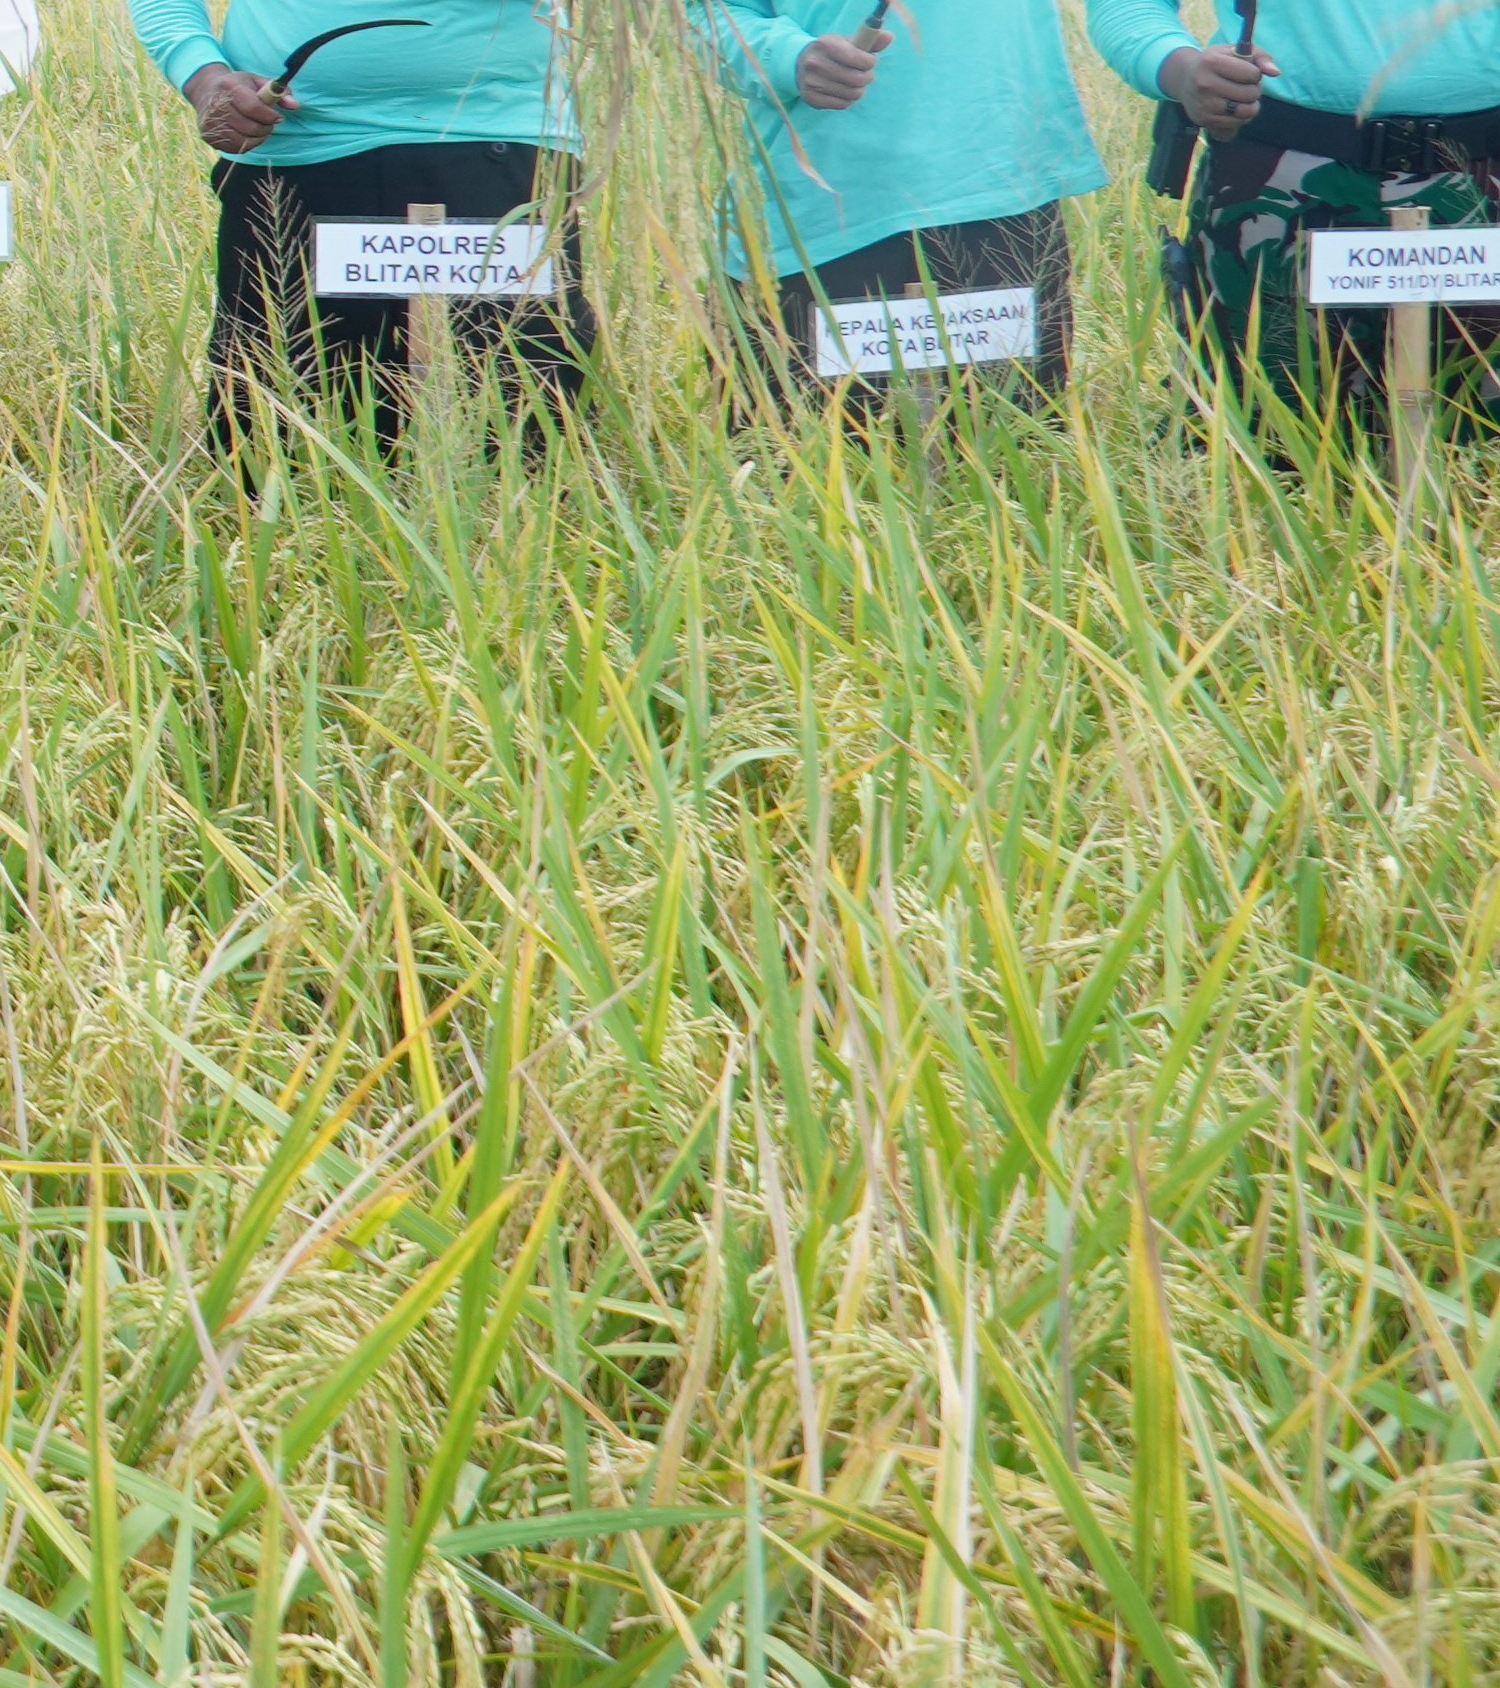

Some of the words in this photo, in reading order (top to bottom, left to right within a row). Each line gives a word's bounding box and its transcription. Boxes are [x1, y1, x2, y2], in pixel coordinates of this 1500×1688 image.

[361, 235, 506, 255] KAPOLRES
[1348, 245, 1486, 268] KOMANDAN
[345, 263, 440, 283] BLITAR
[450, 264, 523, 283] KOTA
[1328, 275, 1382, 290] YONIF
[1387, 273, 1440, 289] 511/DY
